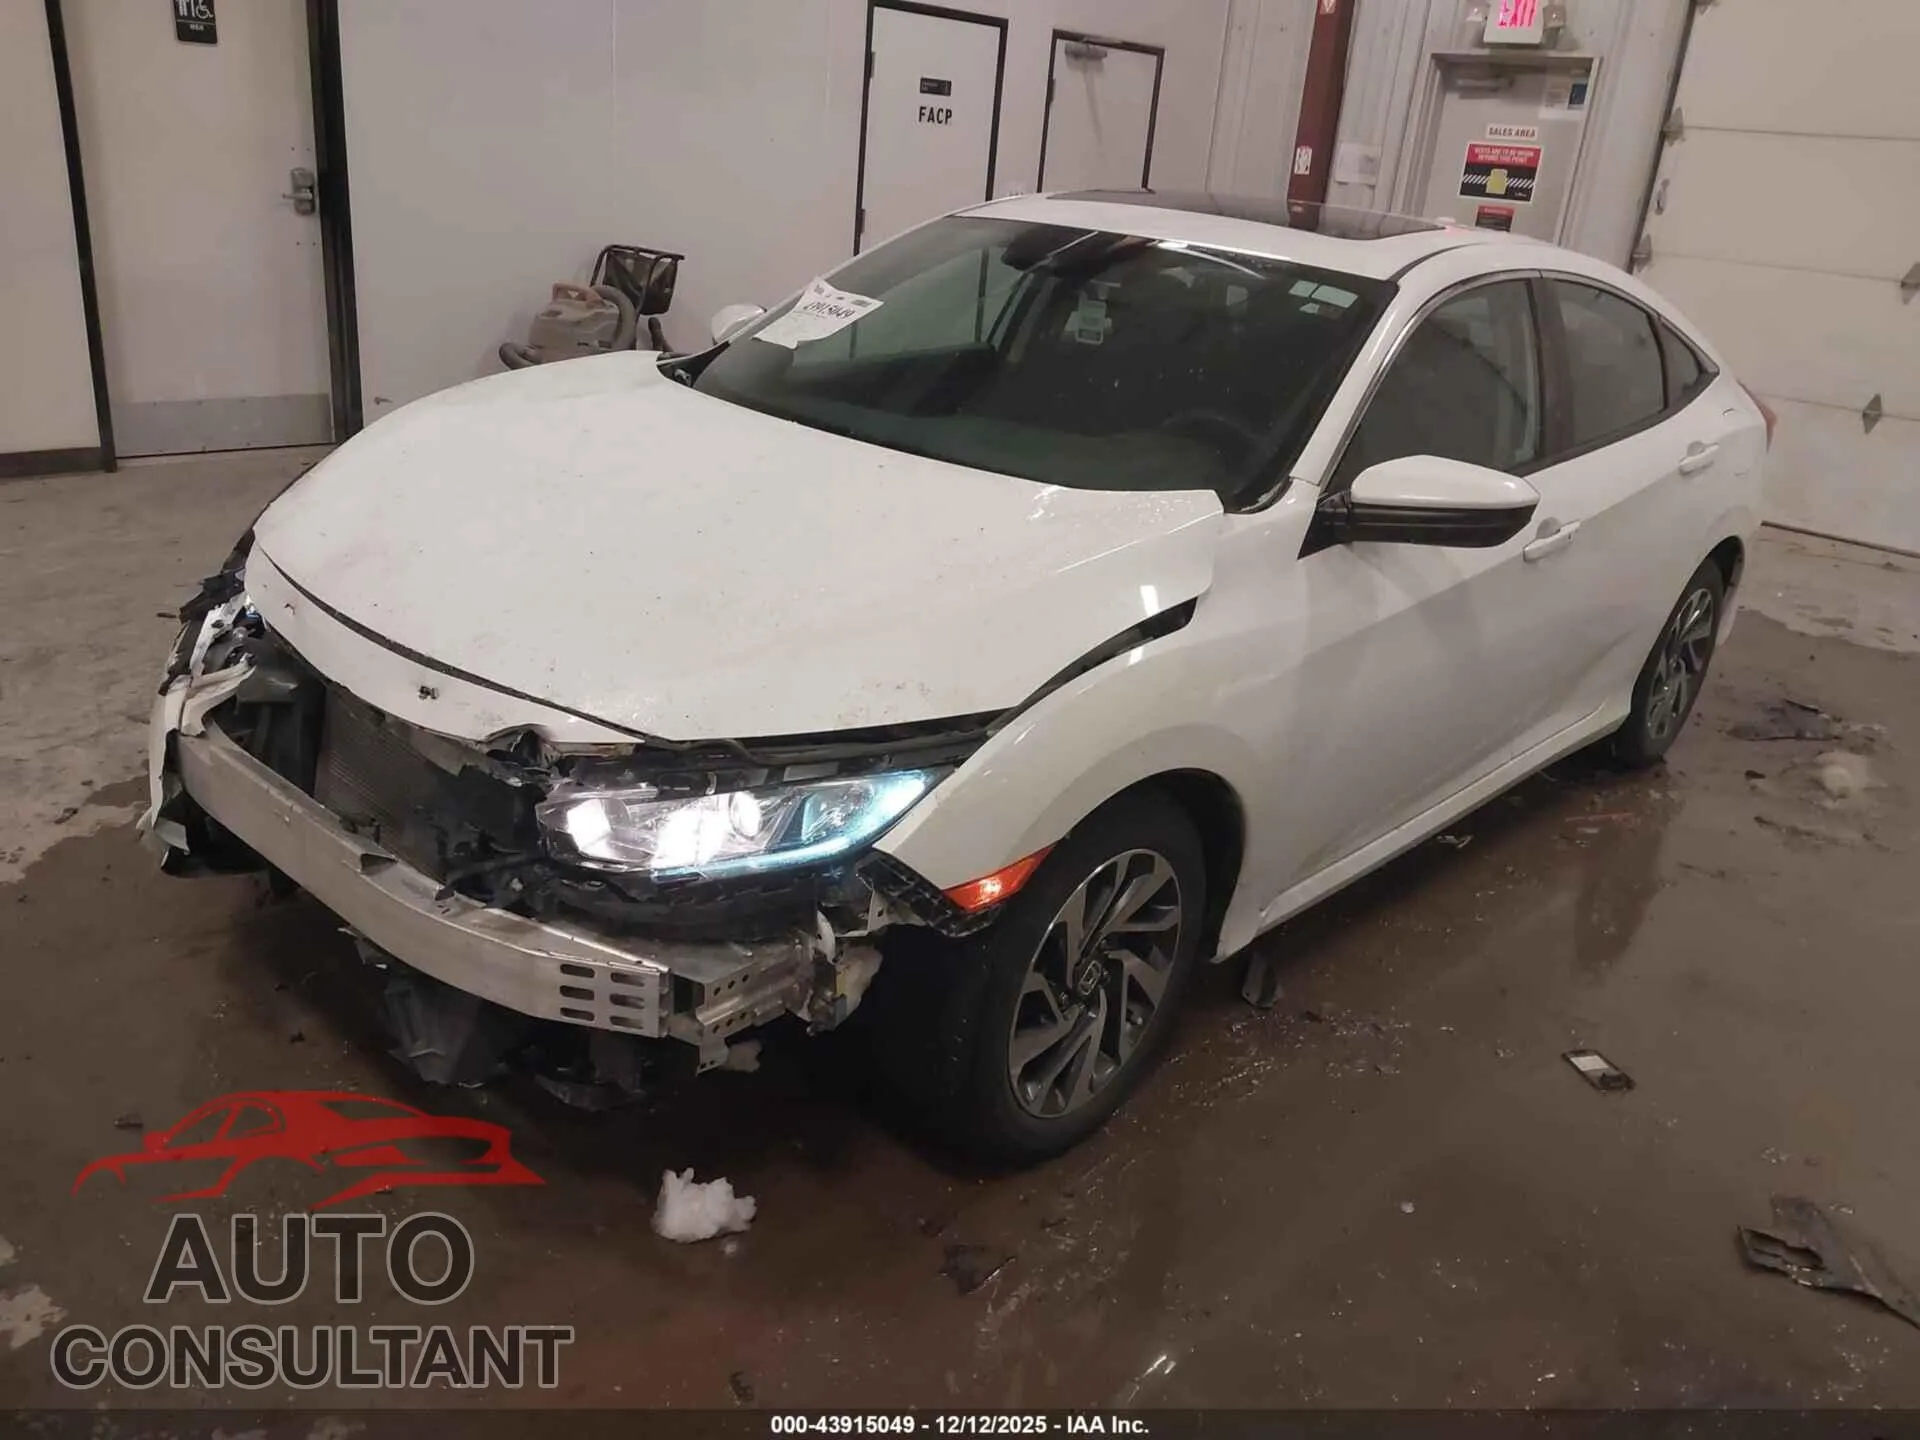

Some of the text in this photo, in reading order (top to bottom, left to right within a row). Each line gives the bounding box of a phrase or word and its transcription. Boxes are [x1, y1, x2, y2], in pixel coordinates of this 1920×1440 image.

[919, 106, 952, 125] FACP
[1489, 127, 1536, 137] SALES AREA
